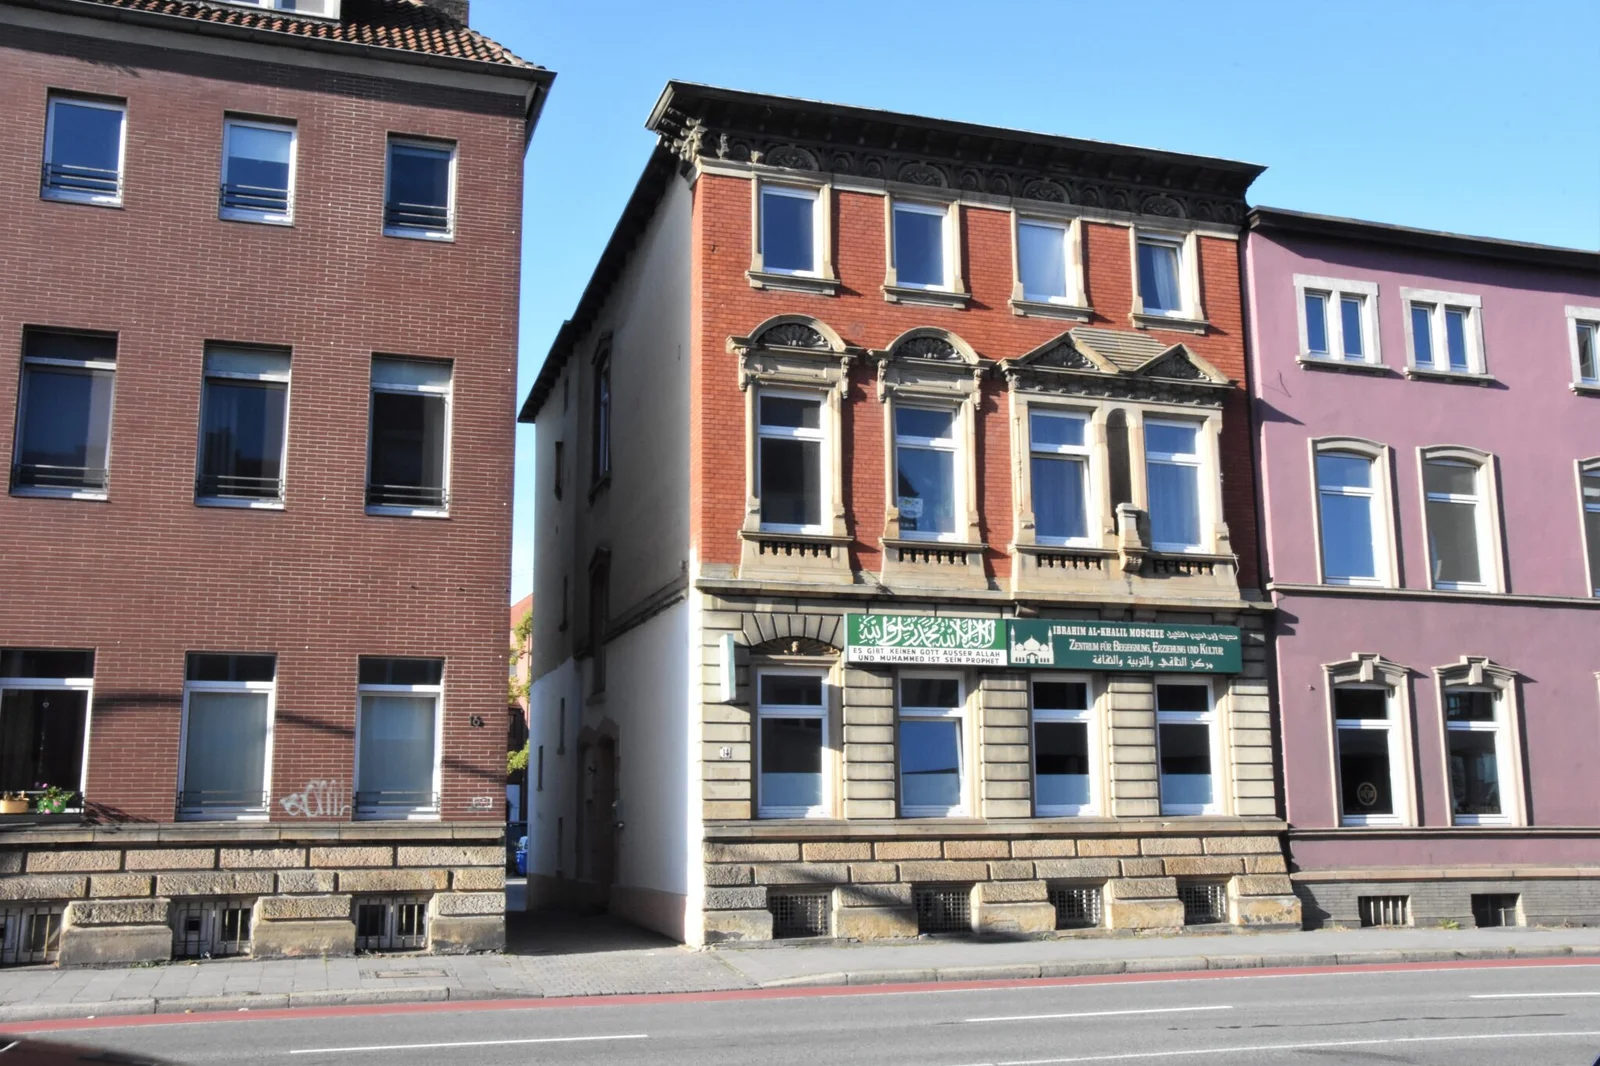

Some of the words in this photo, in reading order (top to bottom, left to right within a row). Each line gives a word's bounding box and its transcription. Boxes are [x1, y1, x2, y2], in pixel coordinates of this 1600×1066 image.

[1052, 625, 1087, 636] IBRAHIM
[1129, 628, 1165, 639] MOSCHEE
[943, 649, 972, 657] AUSSER
[976, 650, 1000, 658] ALLAH
[880, 655, 925, 663] MUHAMMED
[966, 657, 999, 665] PROPHET
[1190, 657, 1214, 670] مركز
